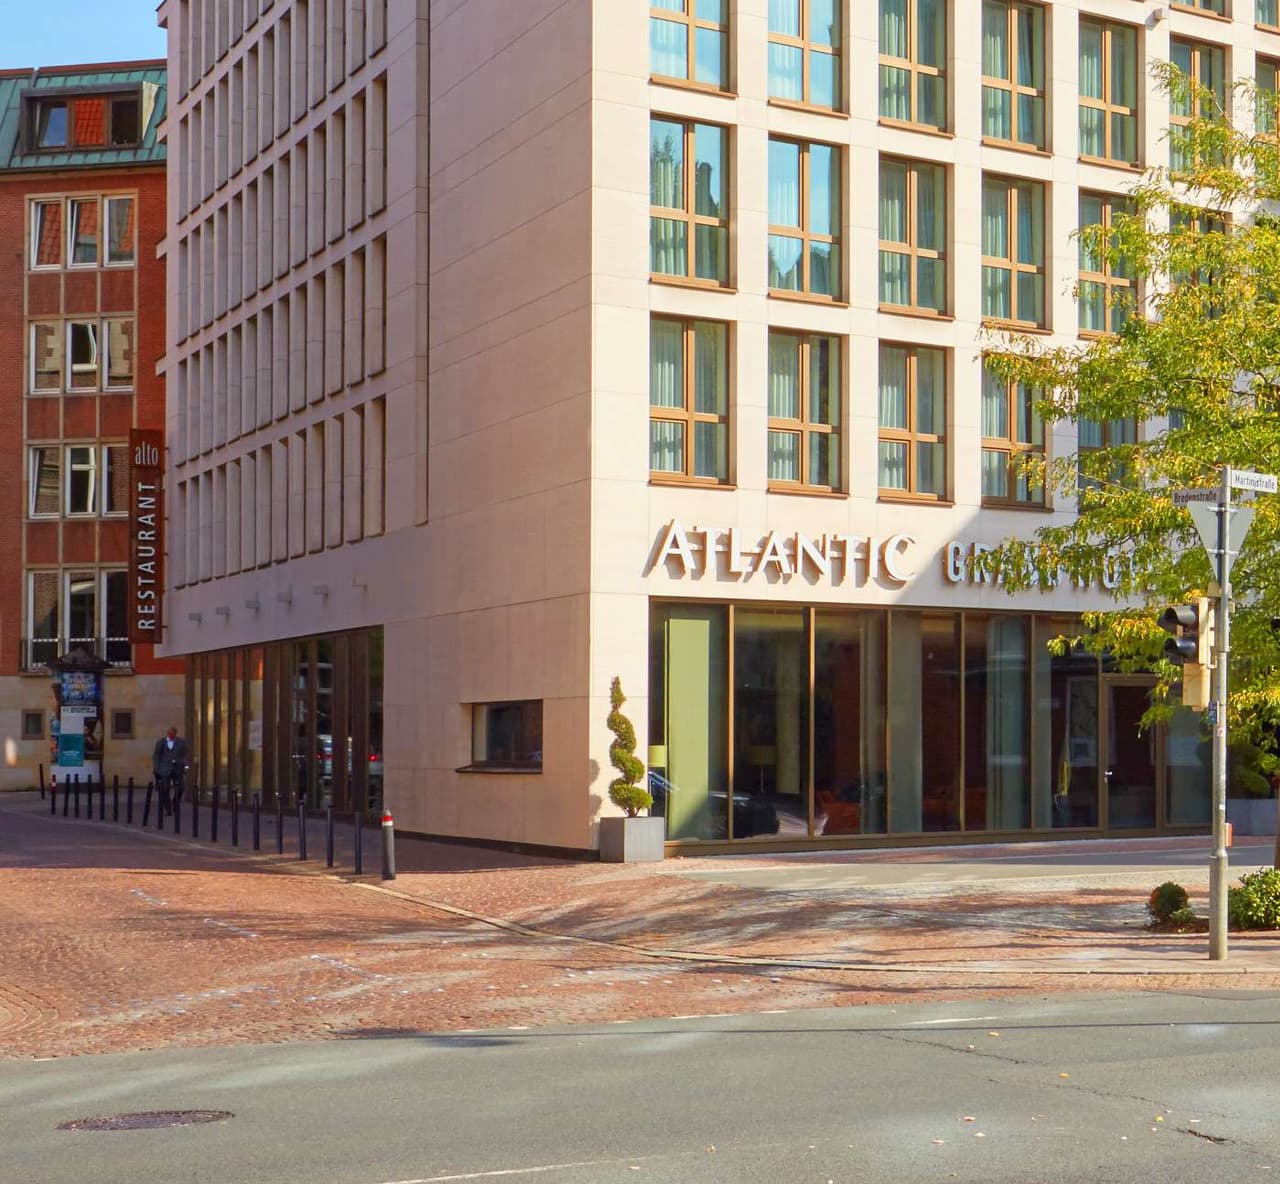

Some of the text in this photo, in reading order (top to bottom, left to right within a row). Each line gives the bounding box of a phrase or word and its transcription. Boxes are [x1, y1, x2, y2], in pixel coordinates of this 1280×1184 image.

[135, 441, 159, 465] alto
[138, 482, 156, 630] RESTAURANT
[652, 518, 918, 583] ATLANTIC
